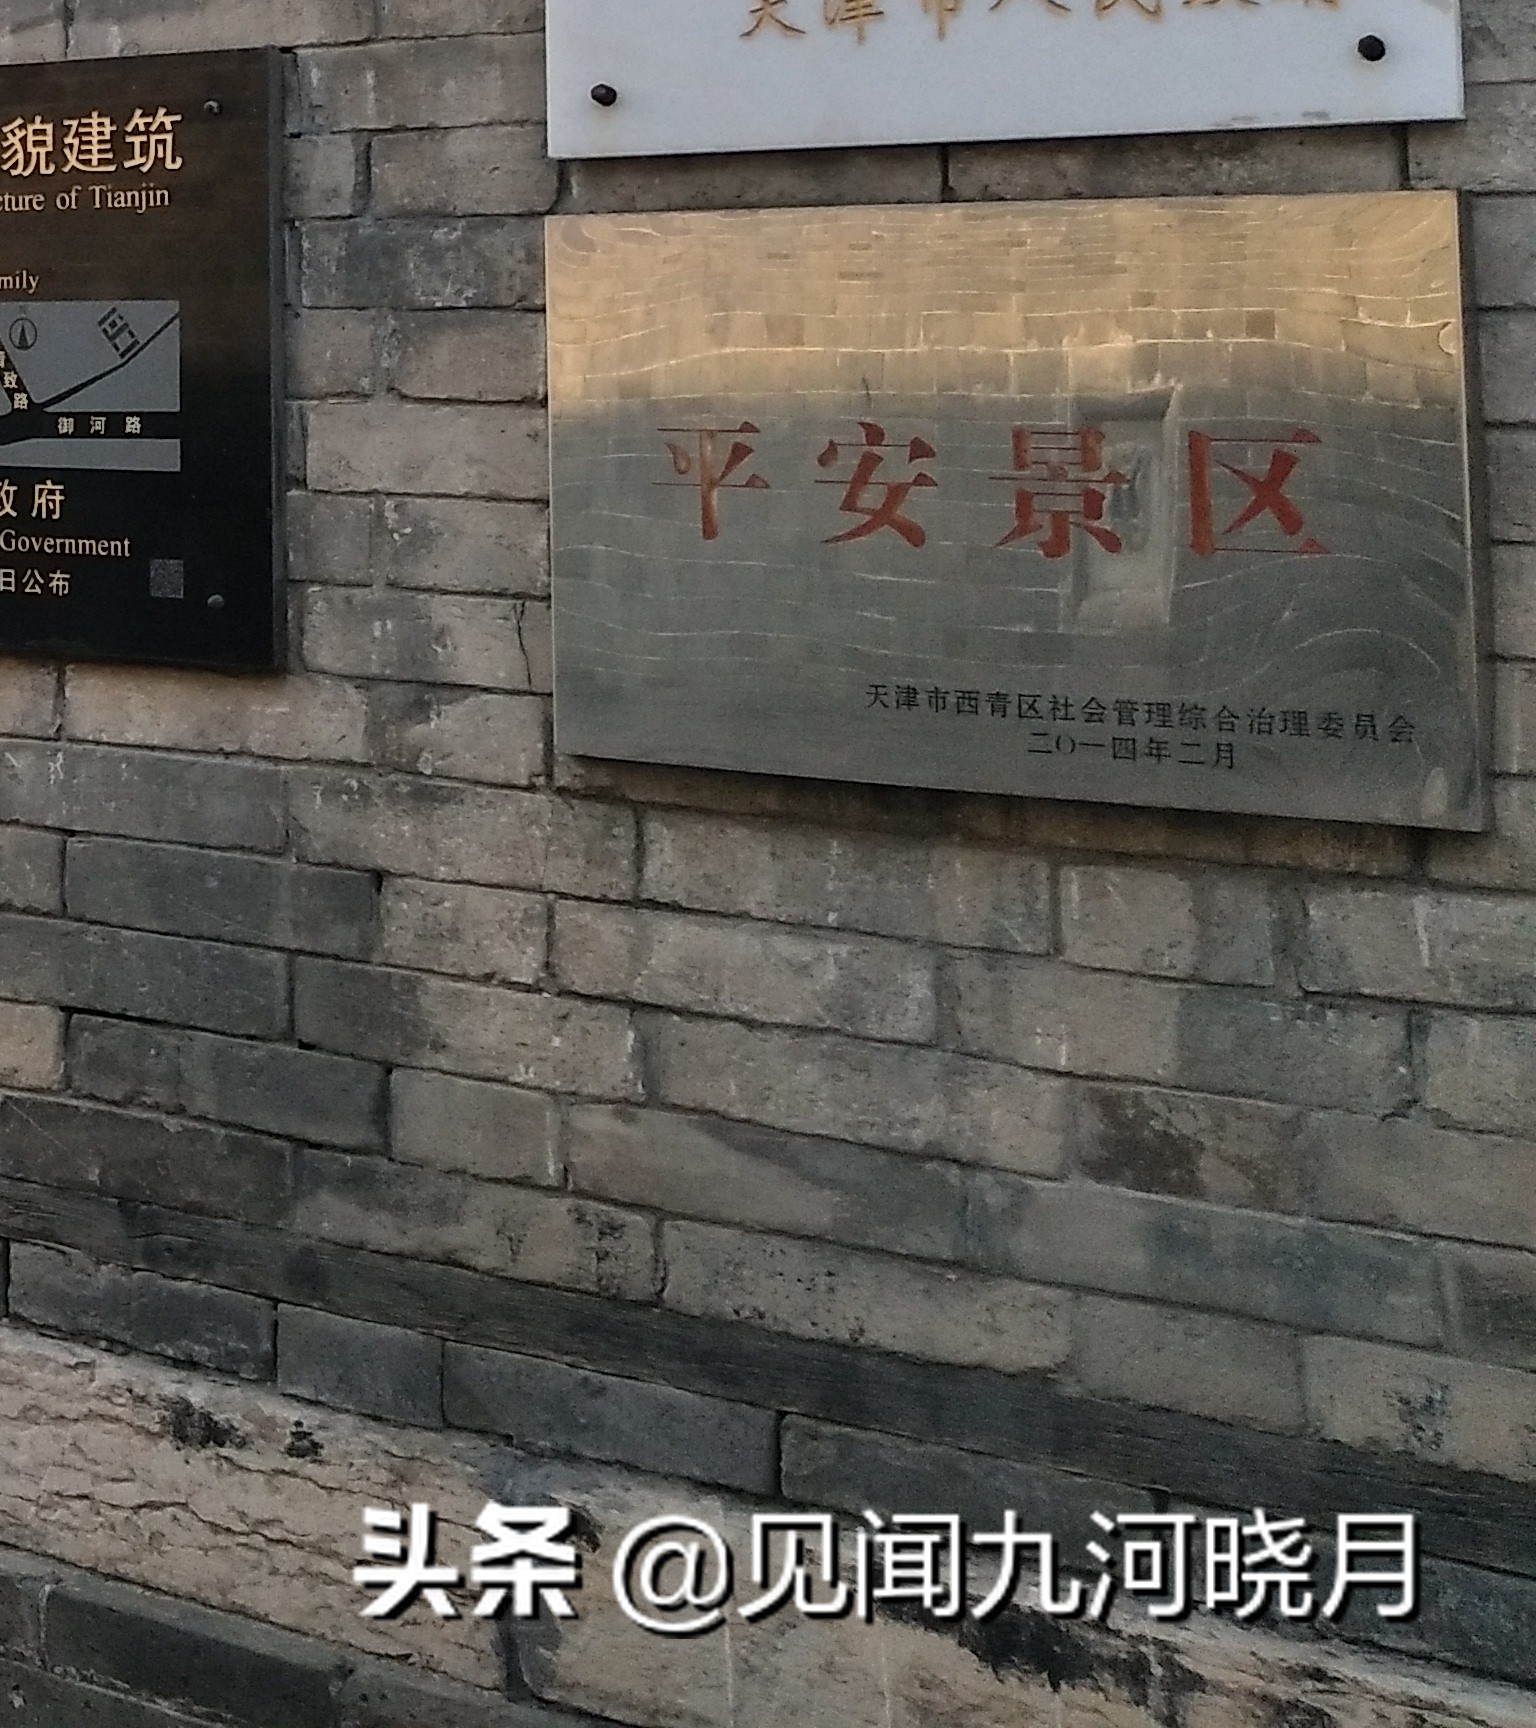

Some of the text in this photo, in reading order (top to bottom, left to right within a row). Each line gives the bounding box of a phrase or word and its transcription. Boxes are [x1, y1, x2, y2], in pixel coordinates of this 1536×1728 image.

[56, 185, 82, 210] of
[89, 183, 170, 214] Tianjin
[57, 416, 142, 435] 御河路
[653, 421, 1334, 561] 平安景区
[0, 529, 131, 558] Government
[865, 682, 1416, 745] 天津市西青区社会管理综合治理委员会
